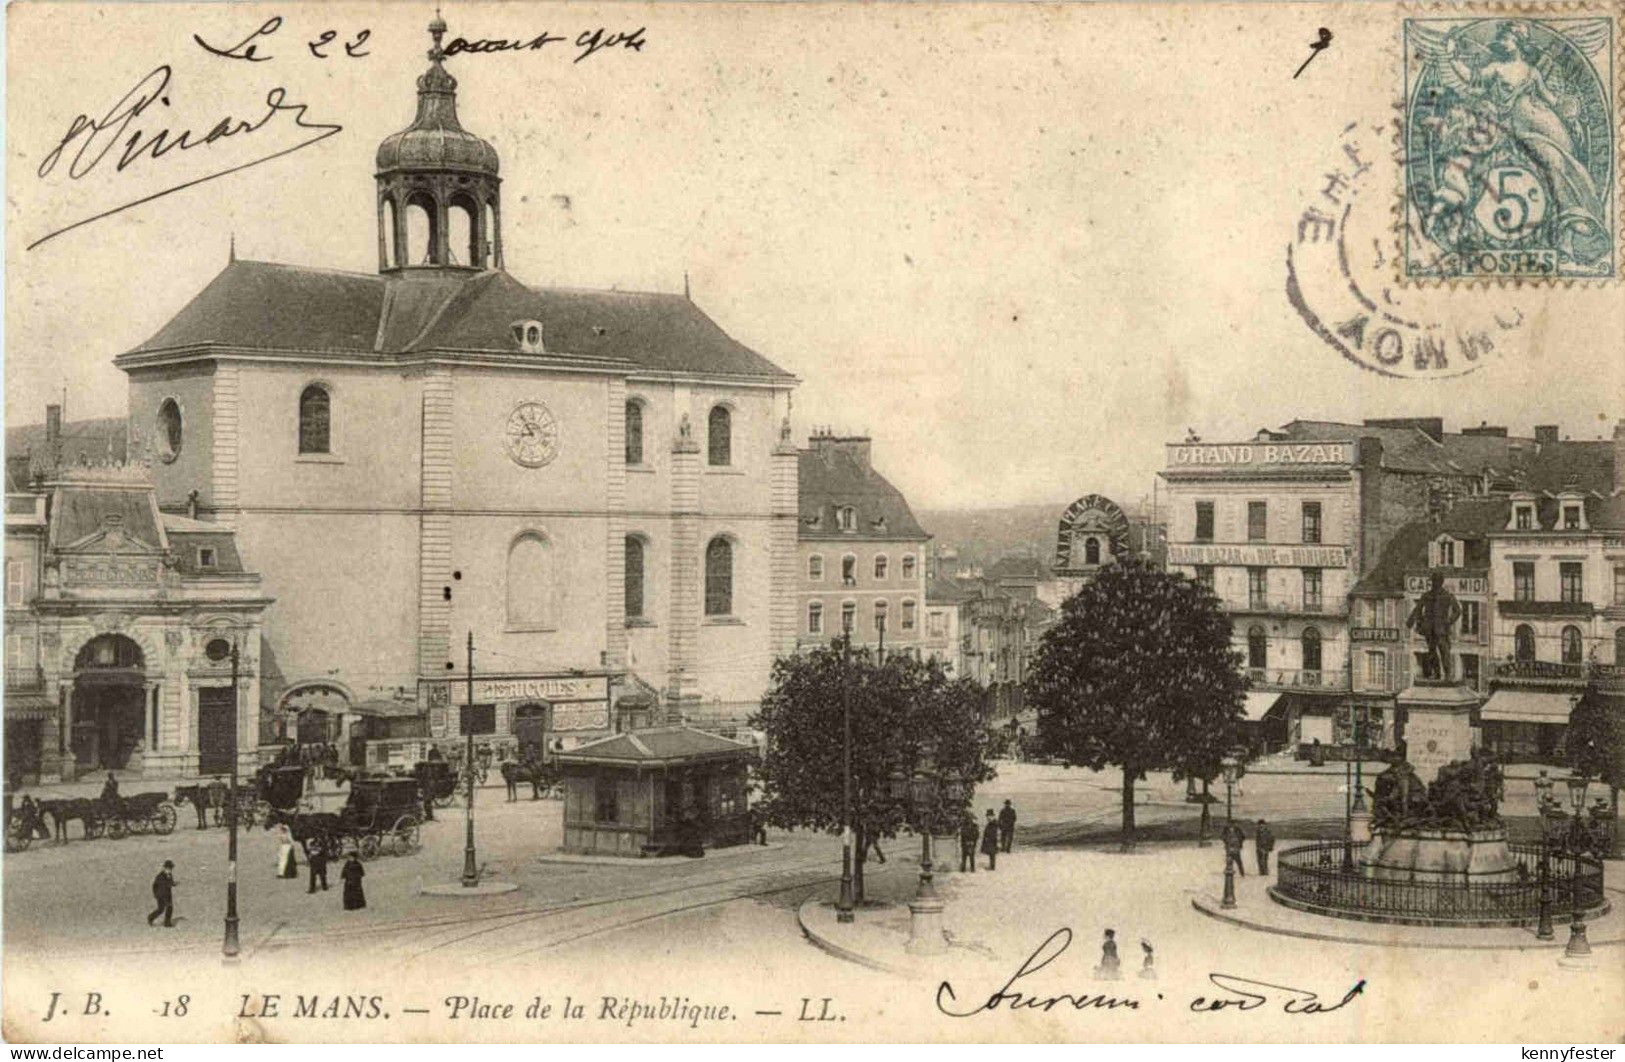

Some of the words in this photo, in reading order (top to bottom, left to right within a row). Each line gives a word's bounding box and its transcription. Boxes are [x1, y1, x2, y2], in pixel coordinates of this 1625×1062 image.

[308, 29, 371, 59] 22
[1174, 445, 1253, 464] GRAND
[1264, 444, 1344, 463] BAZAR
[1408, 577, 1433, 591] CAF
[1458, 579, 1487, 592] MIDI
[83, 993, 110, 1016] B.
[238, 994, 281, 1018] LE
[293, 995, 390, 1020] MANS.
[444, 995, 514, 1020] Place
[525, 996, 552, 1019] de
[563, 996, 584, 1019] la
[598, 996, 737, 1029] République.
[798, 998, 847, 1022] LL.
